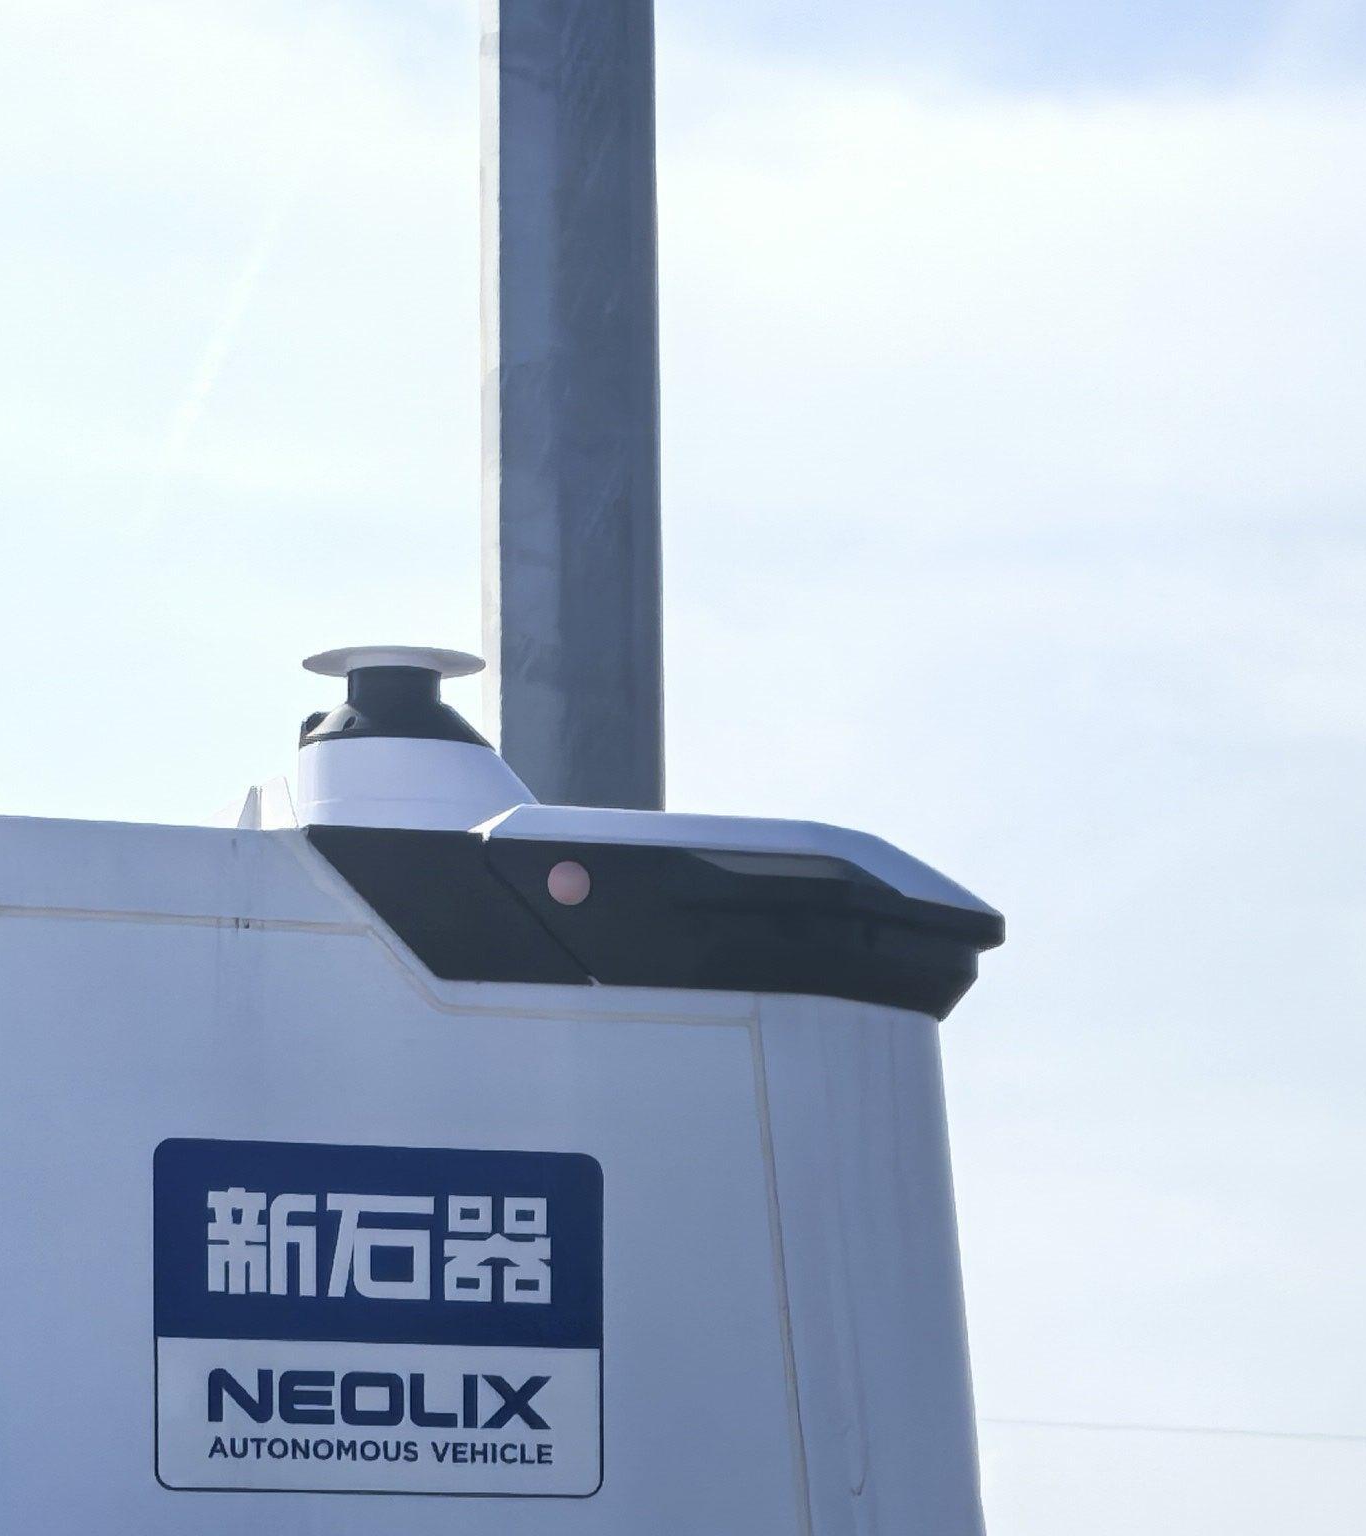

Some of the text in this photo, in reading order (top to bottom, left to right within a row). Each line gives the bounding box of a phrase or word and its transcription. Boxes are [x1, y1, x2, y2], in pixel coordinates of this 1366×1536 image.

[206, 1187, 552, 1305] 新石器
[207, 1367, 552, 1430] NEOLIX
[208, 1437, 553, 1465] AUTONOMOUS VEHICLE
